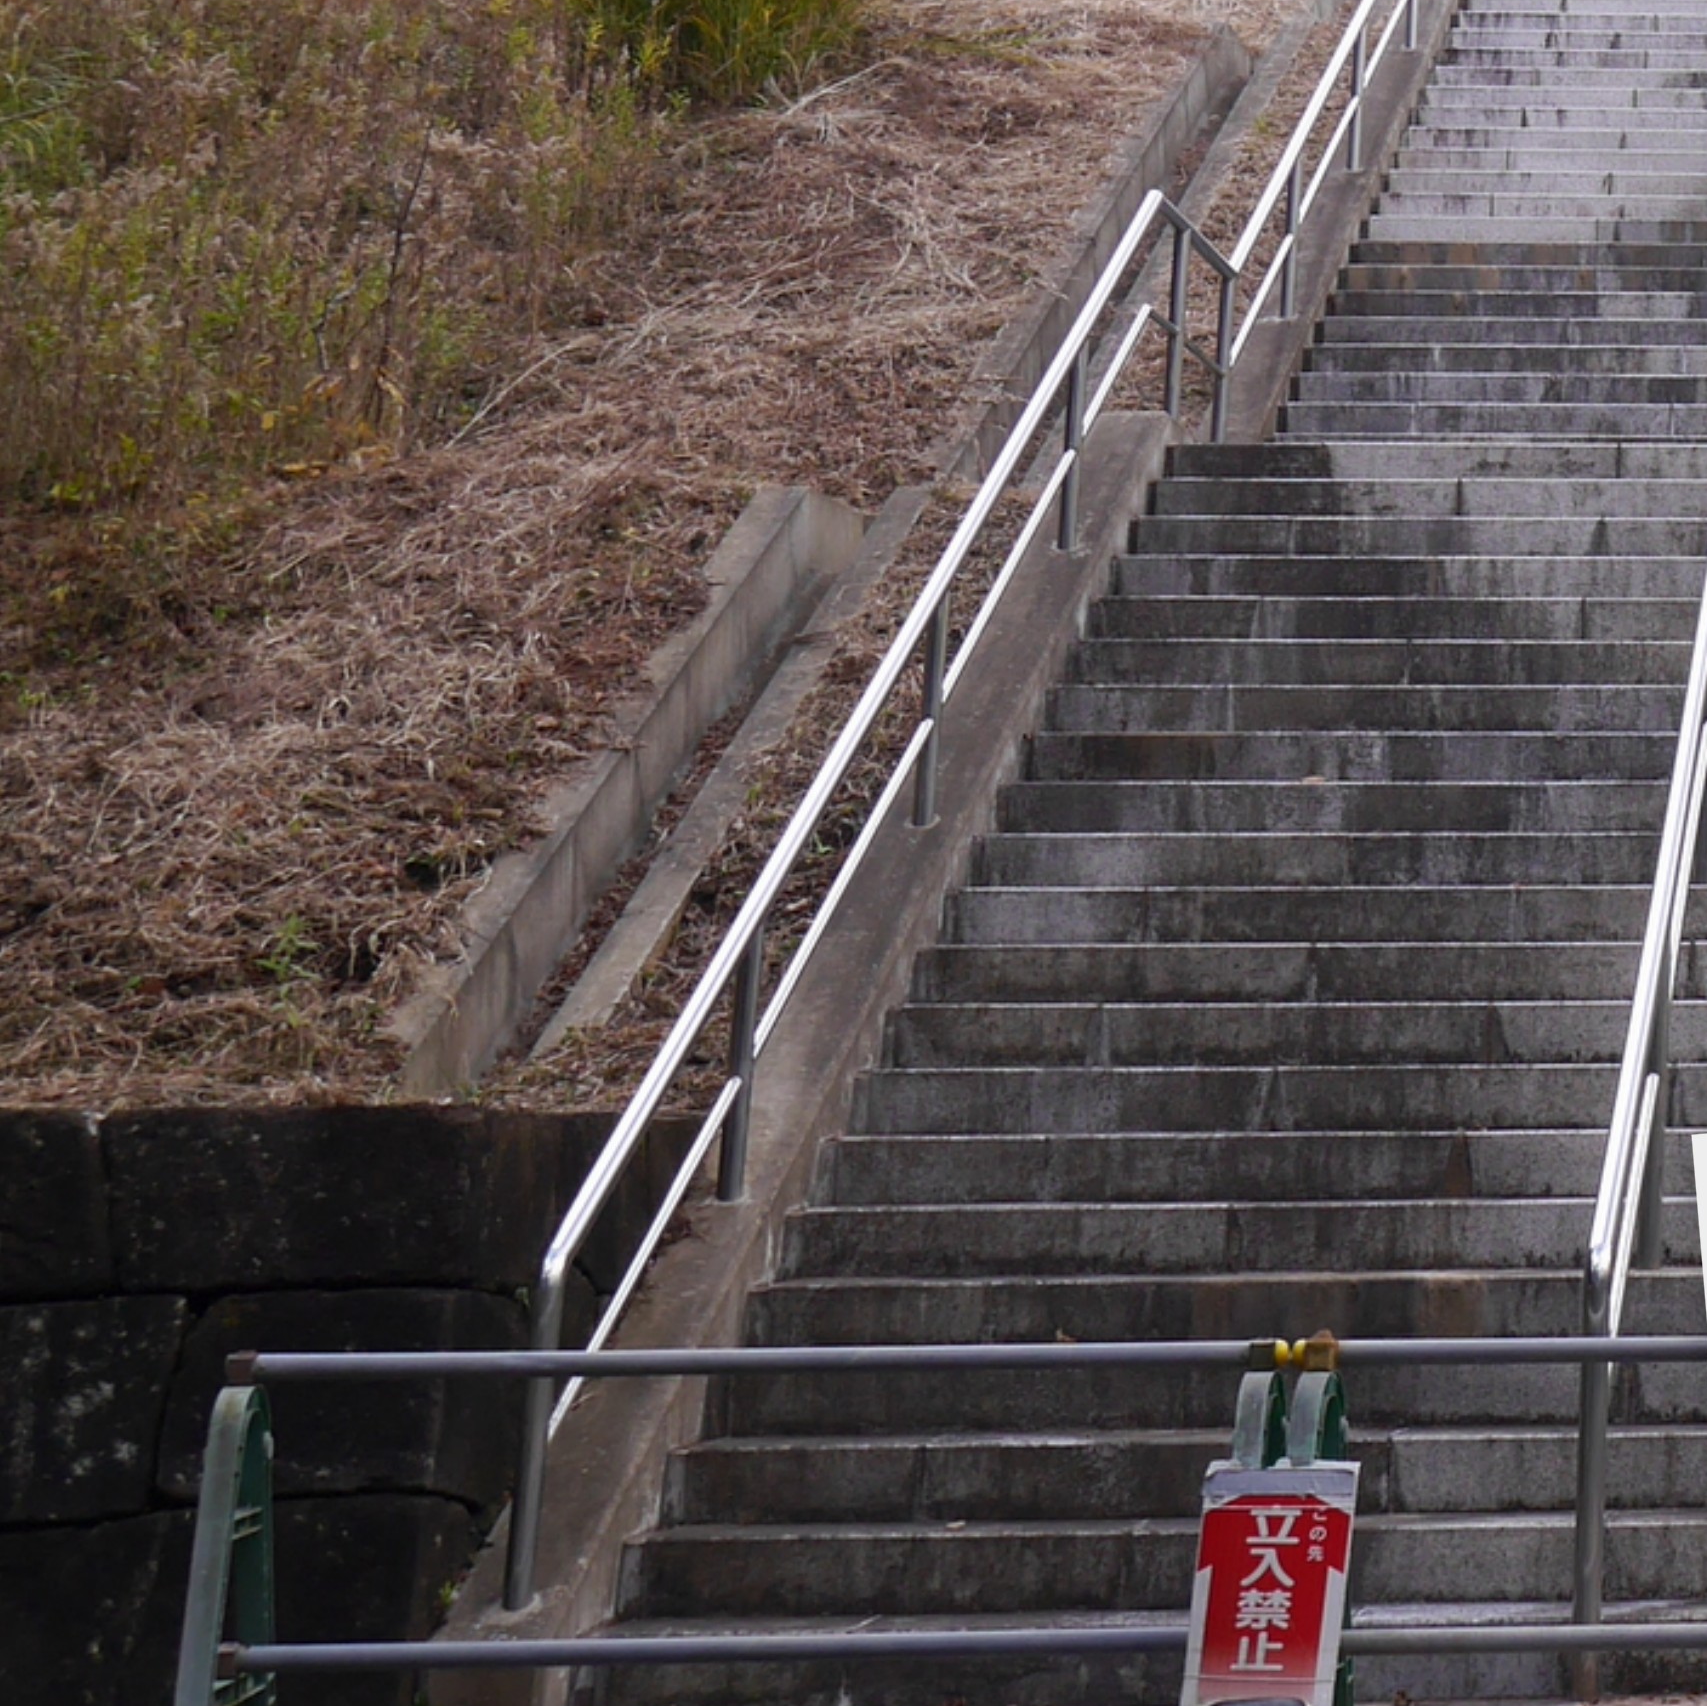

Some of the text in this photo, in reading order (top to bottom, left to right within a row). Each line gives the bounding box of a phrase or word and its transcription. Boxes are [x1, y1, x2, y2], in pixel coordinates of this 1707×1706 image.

[1229, 1504, 1303, 1672] 立入禁止
[1306, 1506, 1328, 1563] この先
